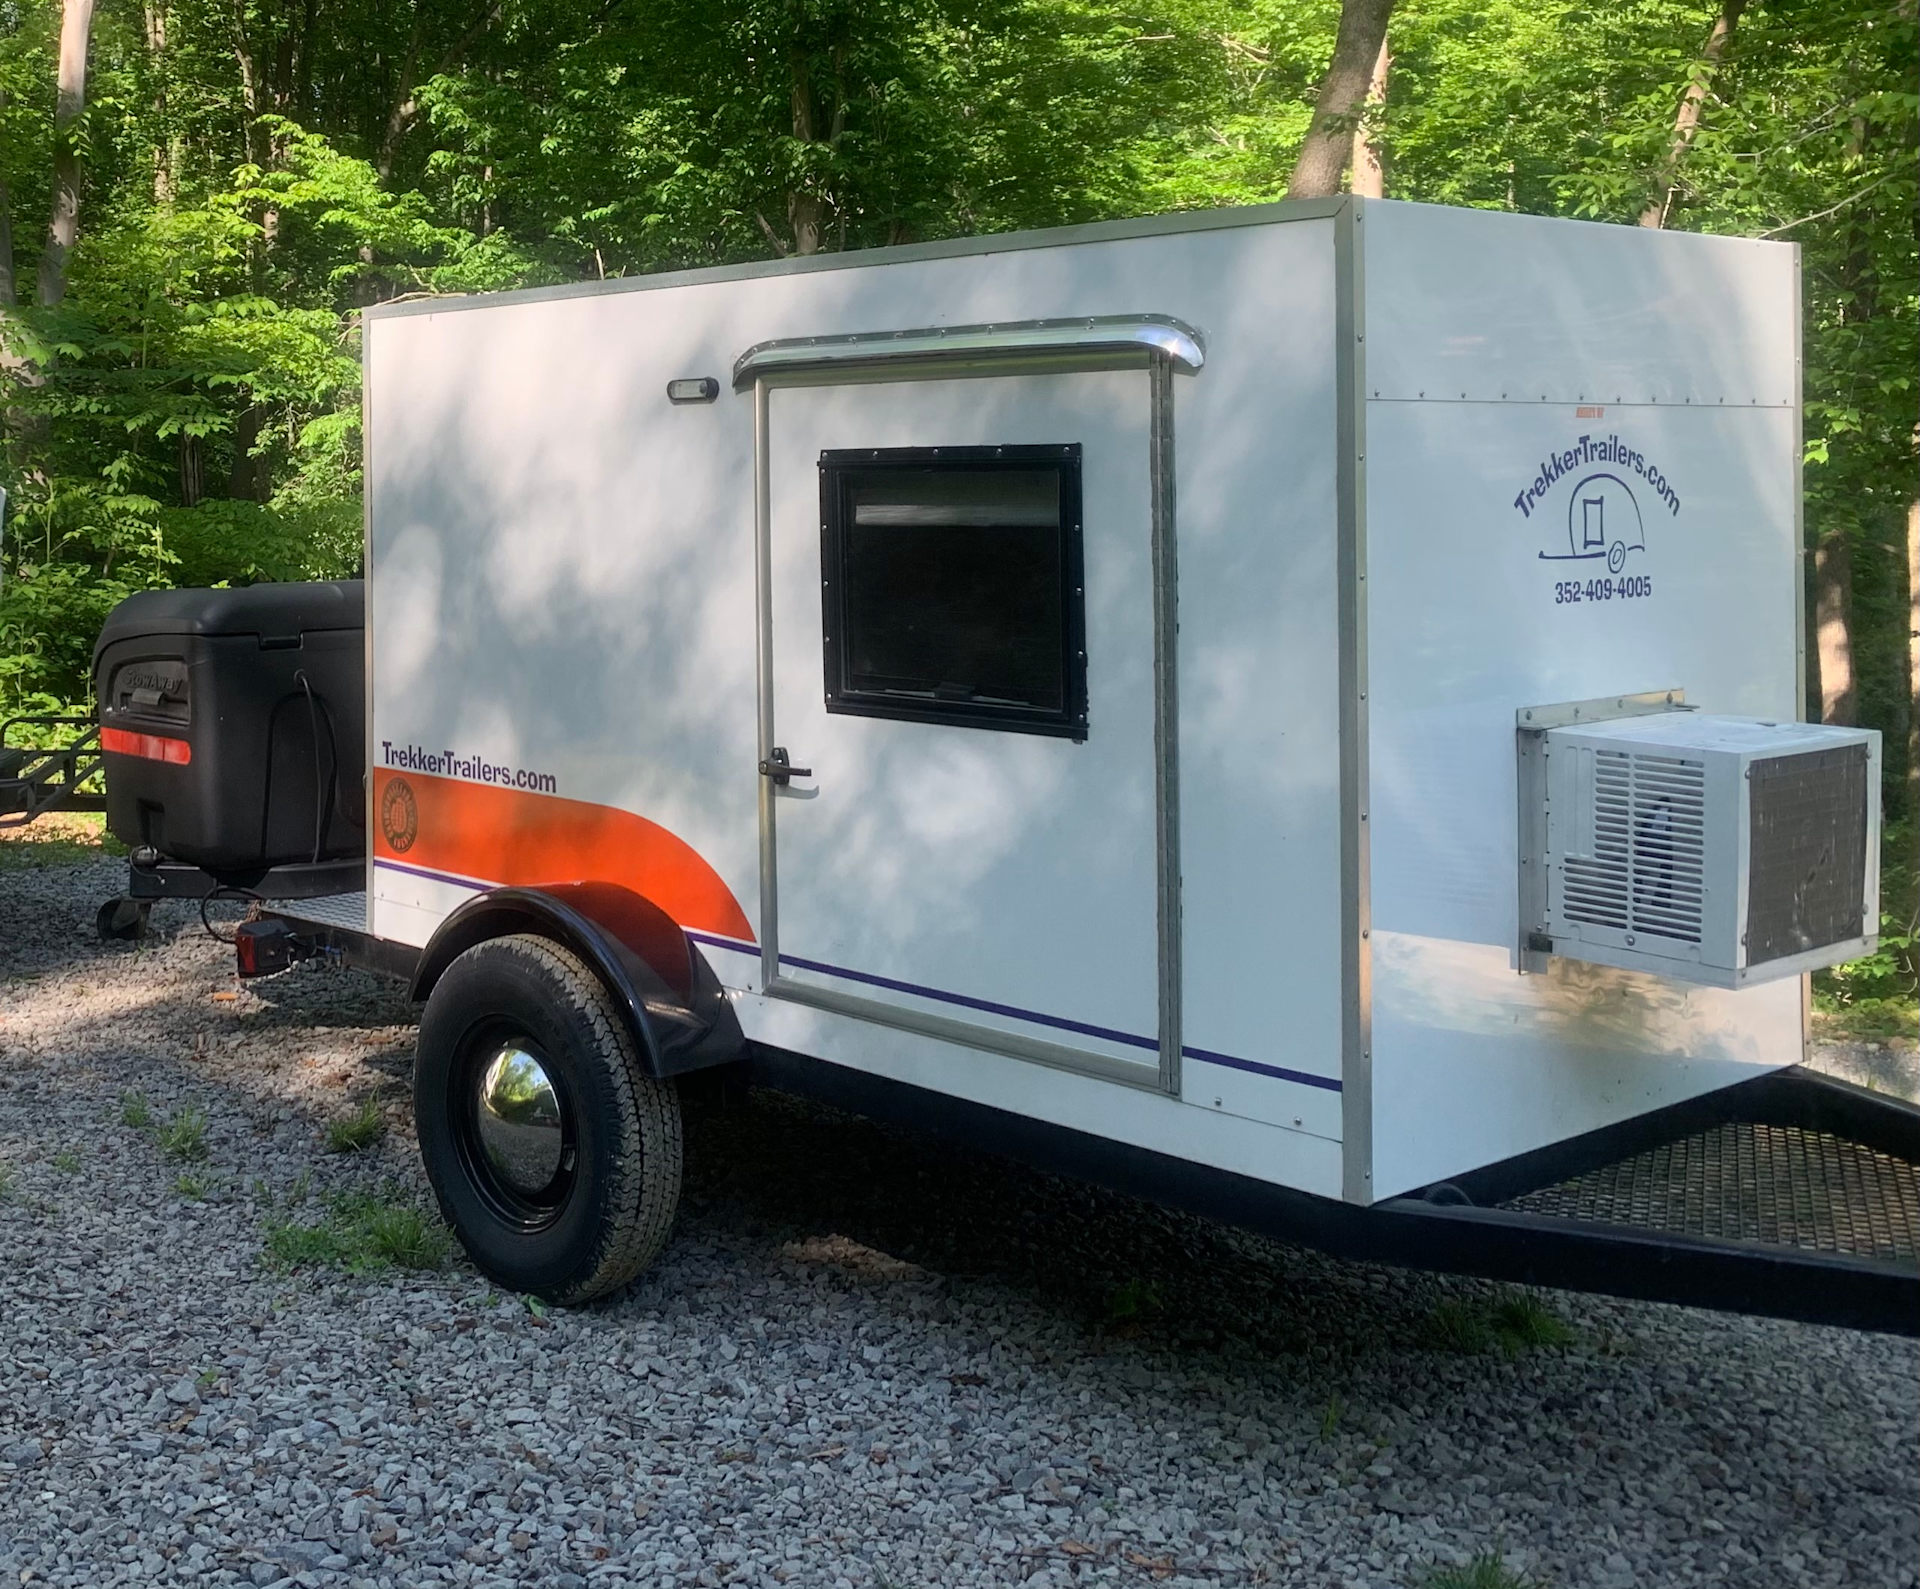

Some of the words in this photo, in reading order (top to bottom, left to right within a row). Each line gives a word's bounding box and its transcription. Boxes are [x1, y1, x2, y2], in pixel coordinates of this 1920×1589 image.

[1513, 434, 1681, 519] TrekkerTrailers.com
[1555, 576, 1652, 604] 352-409-4005
[382, 740, 557, 794] TrekkerTrailers.com
